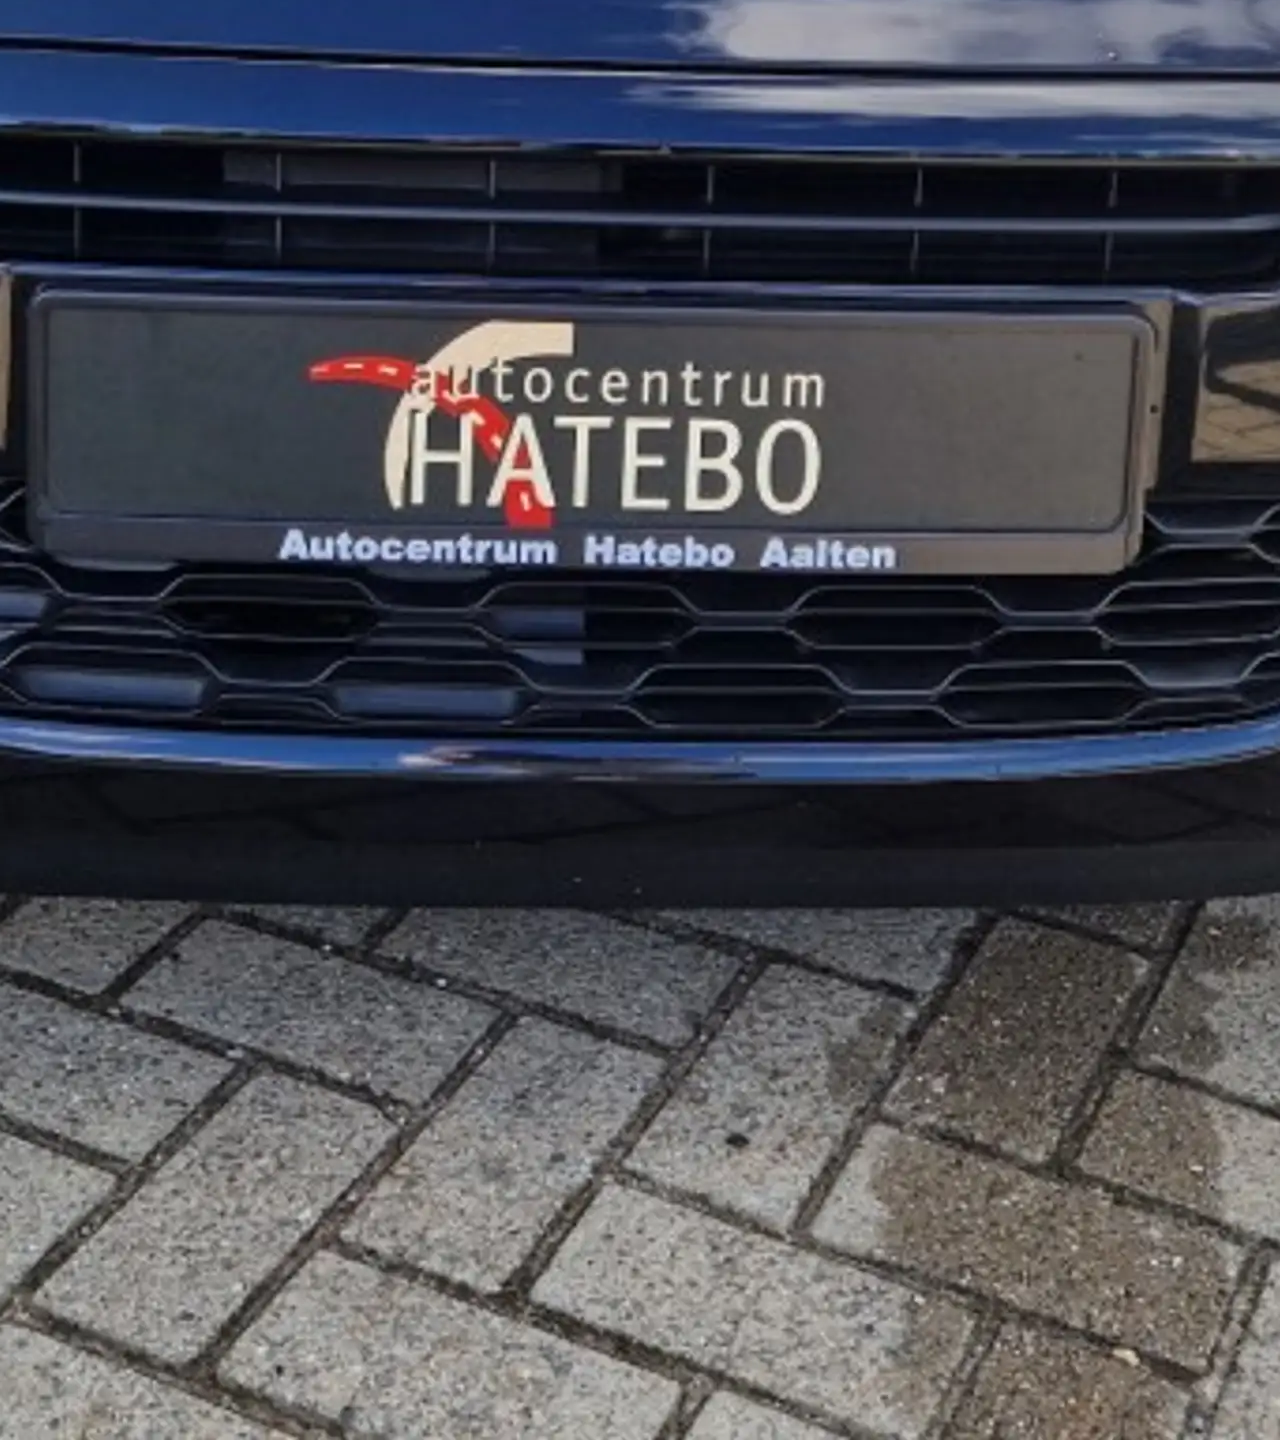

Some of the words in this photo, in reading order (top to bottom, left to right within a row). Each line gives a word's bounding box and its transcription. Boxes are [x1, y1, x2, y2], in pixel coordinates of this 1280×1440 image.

[410, 359, 826, 409] autocentrum
[410, 412, 821, 515] HATEBO
[279, 529, 558, 564] Autocentrum
[583, 535, 735, 569] Hatebo
[759, 536, 897, 569] Aalten
